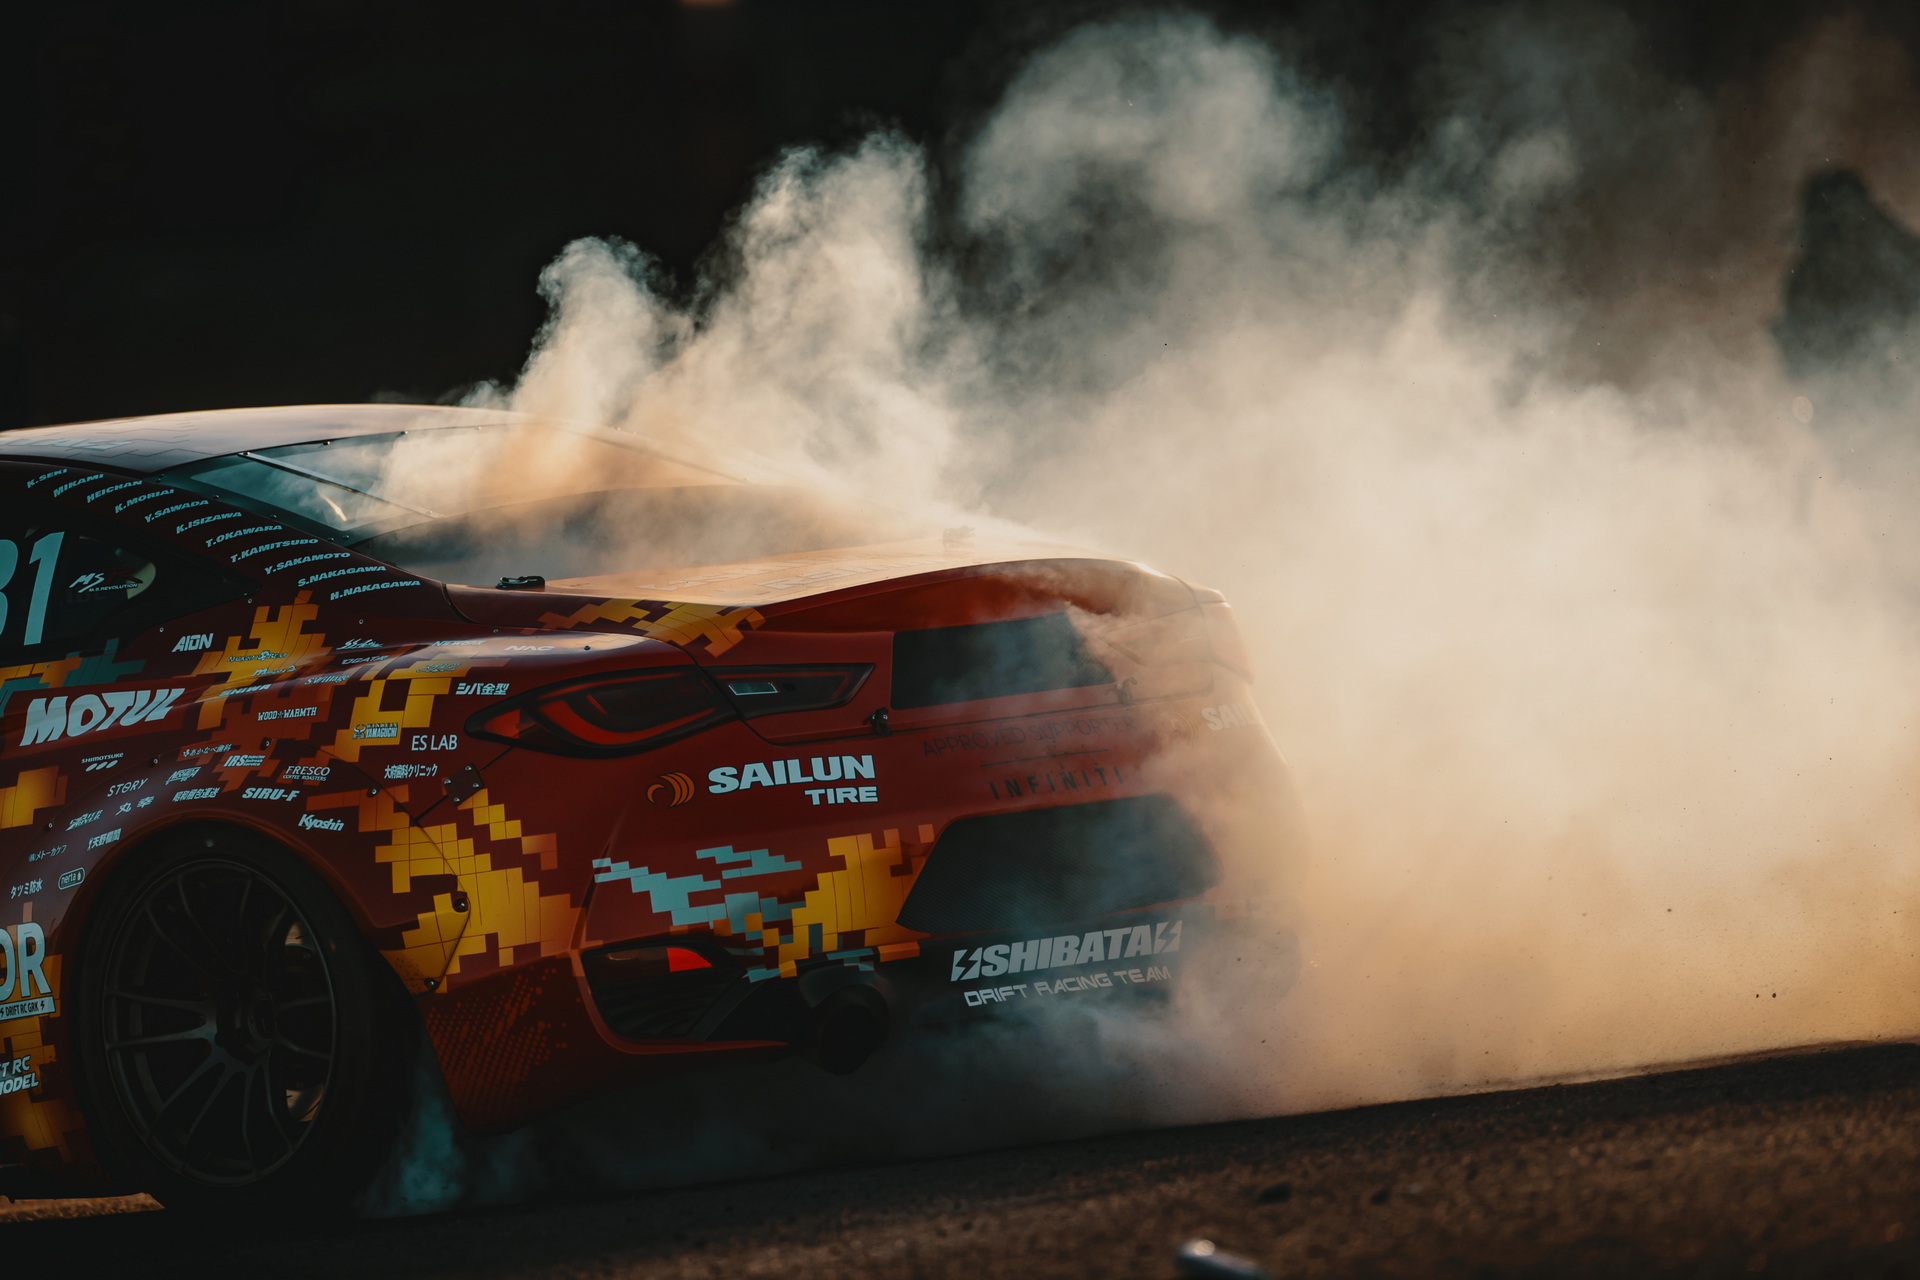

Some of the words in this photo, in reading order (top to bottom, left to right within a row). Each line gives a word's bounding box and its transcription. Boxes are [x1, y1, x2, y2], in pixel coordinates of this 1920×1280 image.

[26, 468, 68, 489] K.SEKI
[53, 473, 104, 498] MIKAMI
[86, 480, 143, 503] HEICHAN
[144, 499, 210, 523] Y.SAWADA
[176, 512, 243, 534] K.ISIZAWA
[205, 524, 283, 548] T.OKAWARA
[230, 538, 319, 563] T.KAMITSUBO
[264, 552, 351, 575] Y.SAKAMOTO
[297, 566, 386, 587] S.NAKAGAWA
[330, 580, 421, 601] H.NAKAGAWA
[171, 633, 214, 653] AION
[455, 682, 510, 695] シバ金型
[19, 688, 185, 747] MOTUL
[257, 710, 278, 721] WOOD
[283, 706, 318, 719] WARMTH
[411, 735, 428, 751] ES
[430, 734, 458, 751] LAB
[921, 726, 1027, 757] APPROVED
[285, 765, 331, 776] FRESCO
[707, 754, 876, 796] SAILUN
[989, 766, 1125, 801] INFINITI
[241, 787, 301, 802] SIRU-F
[804, 786, 879, 806] TIRE
[297, 813, 345, 832] Kyoshin
[981, 925, 1157, 979] SHIBATA
[964, 983, 1028, 1007] DRIFT
[1034, 970, 1114, 996] RACING
[1120, 964, 1172, 986] TEAM
[5, 1004, 20, 1017] DRIFT
[12, 1055, 31, 1075] RC
